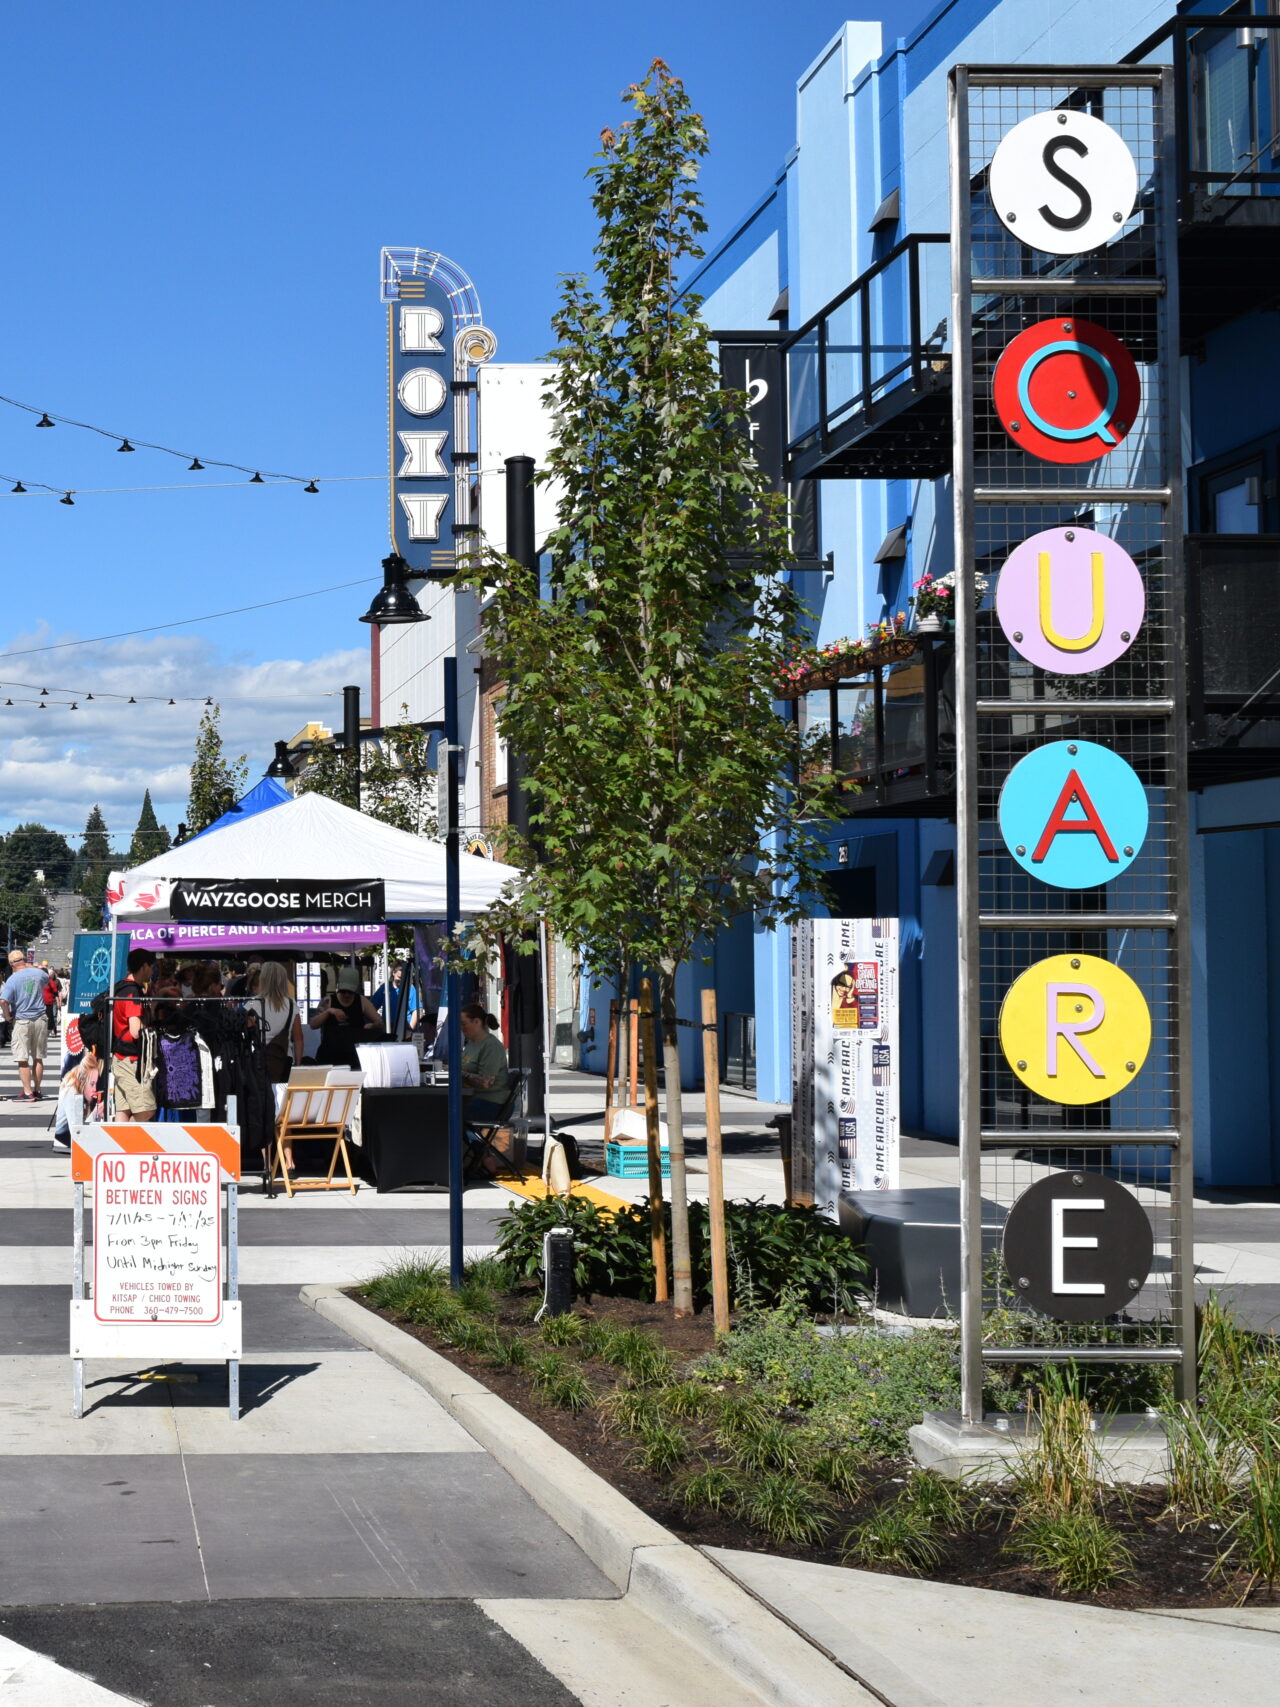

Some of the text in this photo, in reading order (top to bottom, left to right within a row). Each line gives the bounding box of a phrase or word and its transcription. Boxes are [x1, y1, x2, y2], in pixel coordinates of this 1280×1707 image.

[397, 304, 450, 543] ROXY
[183, 891, 371, 908] WAYZGOOSE MERCH
[158, 928, 175, 940] OF
[178, 926, 225, 938] PIERCE
[228, 925, 258, 936] AND
[261, 924, 308, 935] KITSAP
[312, 924, 380, 933] COUNTIES
[878, 1049, 890, 1065] USA
[846, 1121, 856, 1137] USA
[103, 1161, 211, 1183] NO PARKING
[842, 1162, 851, 1189] ORE
[106, 1190, 207, 1205] BETWEEN SIGNS
[107, 1234, 199, 1254] From 3pm Friday
[106, 1255, 137, 1269] Until
[142, 1257, 184, 1276] Midnight
[120, 1282, 194, 1291] VEHICLES TOWED BY
[112, 1294, 137, 1303] KITSAP
[149, 1294, 171, 1303] CHICO
[174, 1294, 201, 1303] TOWING
[110, 1306, 203, 1315] PHONE 360-479-7500
